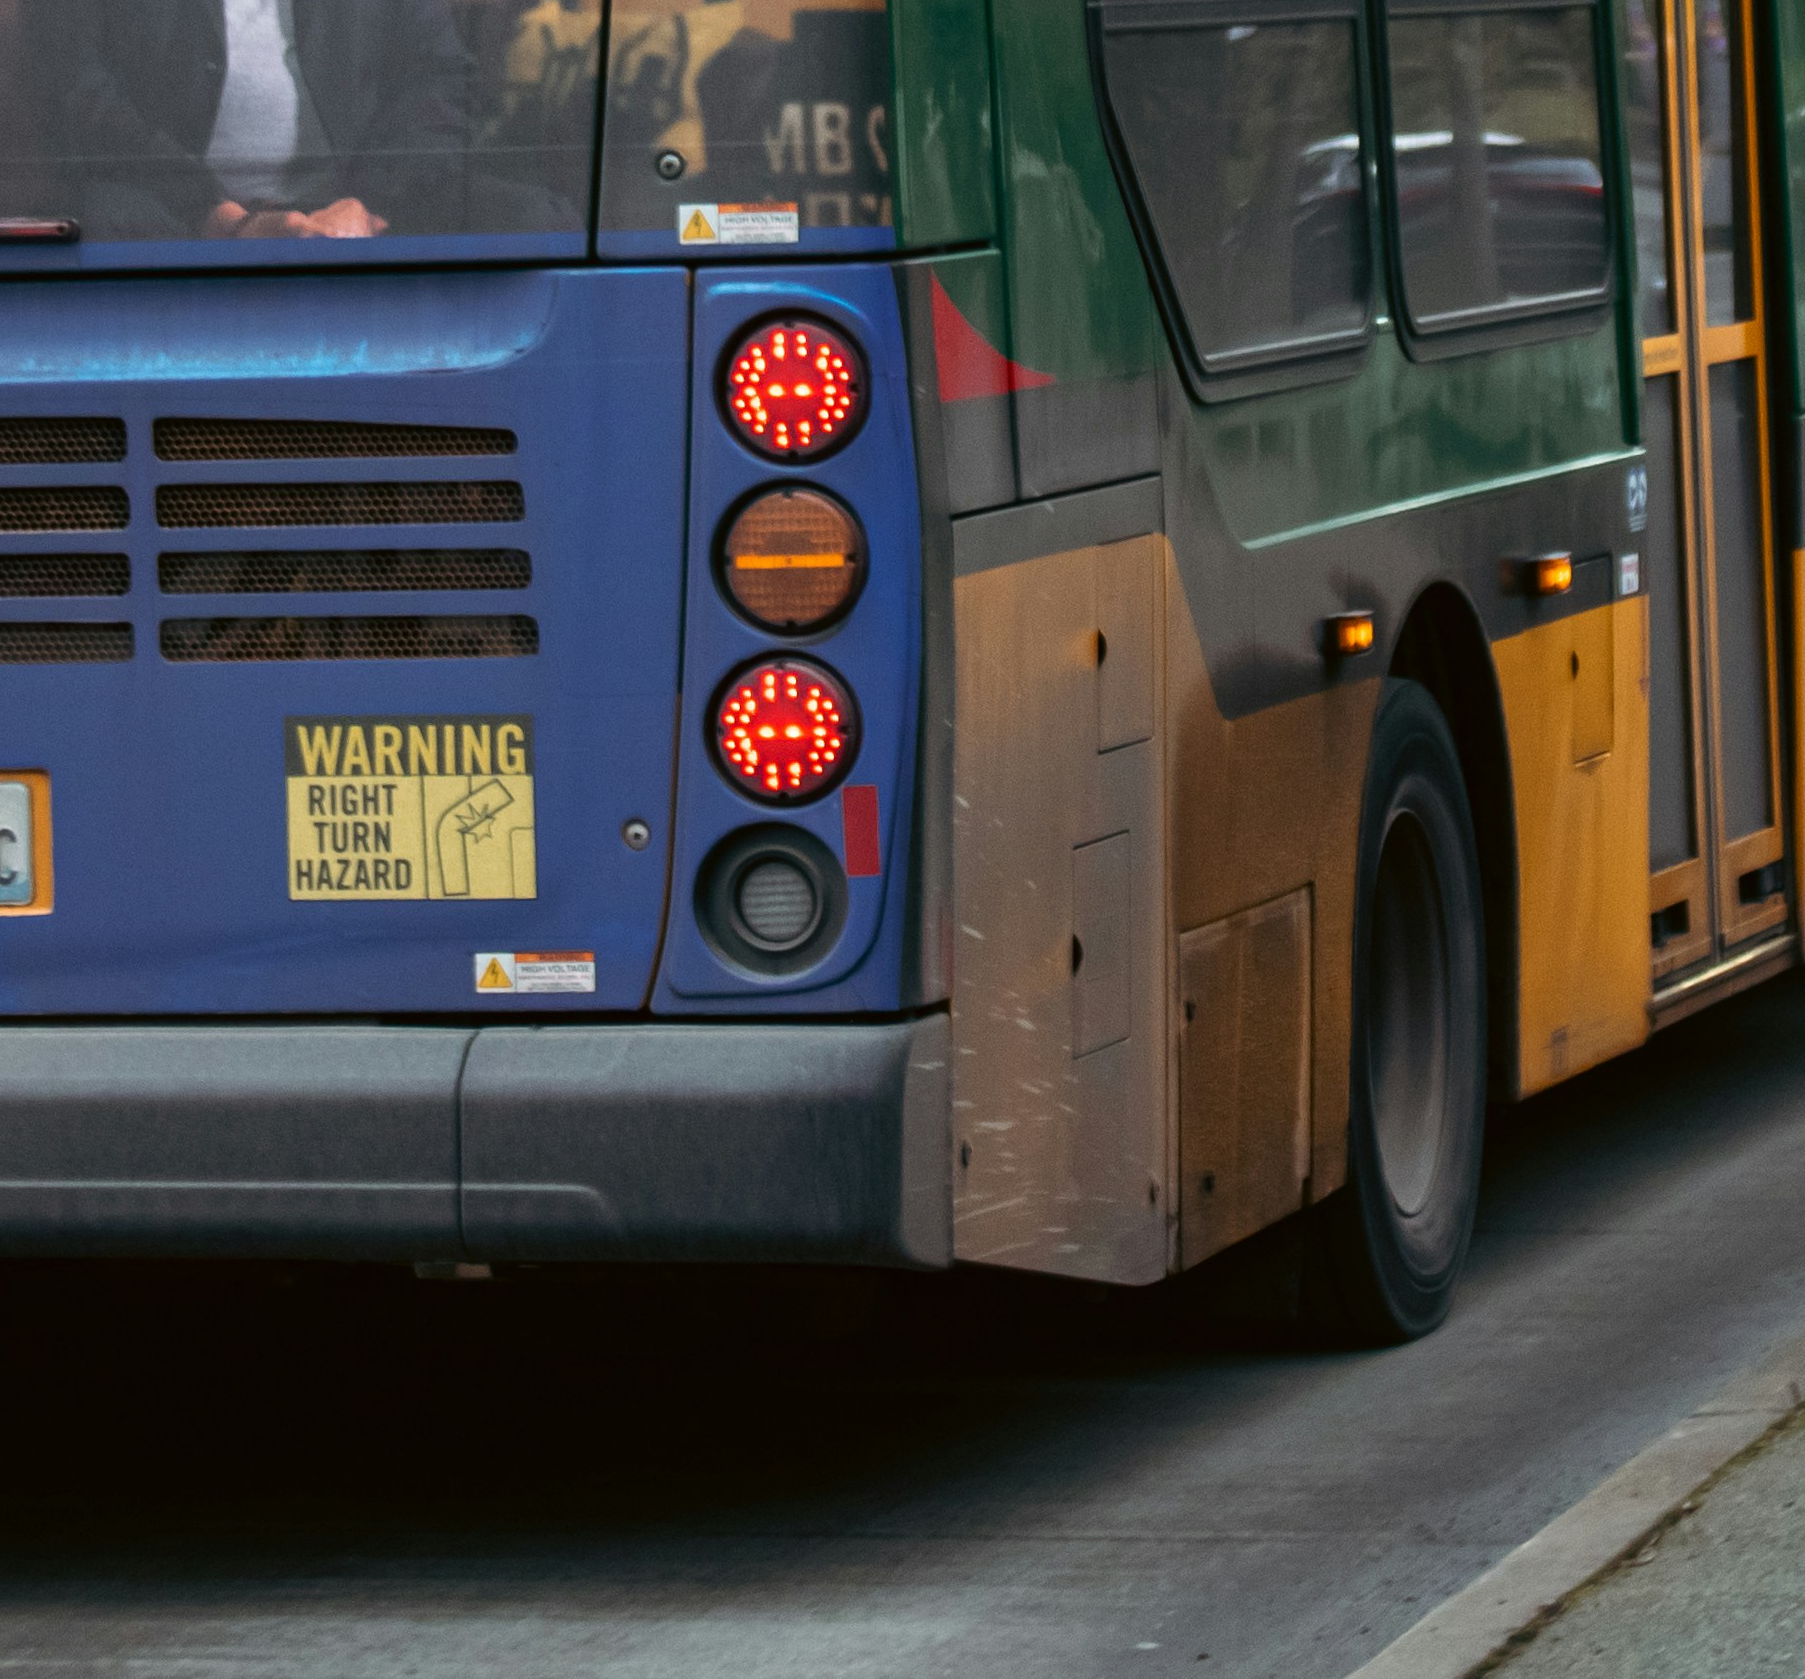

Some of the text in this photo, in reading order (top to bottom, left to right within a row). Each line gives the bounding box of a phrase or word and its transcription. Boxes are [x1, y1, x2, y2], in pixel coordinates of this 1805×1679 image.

[297, 724, 526, 776] WARNING
[308, 784, 397, 816] RIGHT
[314, 822, 392, 853] TURN
[296, 859, 413, 891] HAZARD
